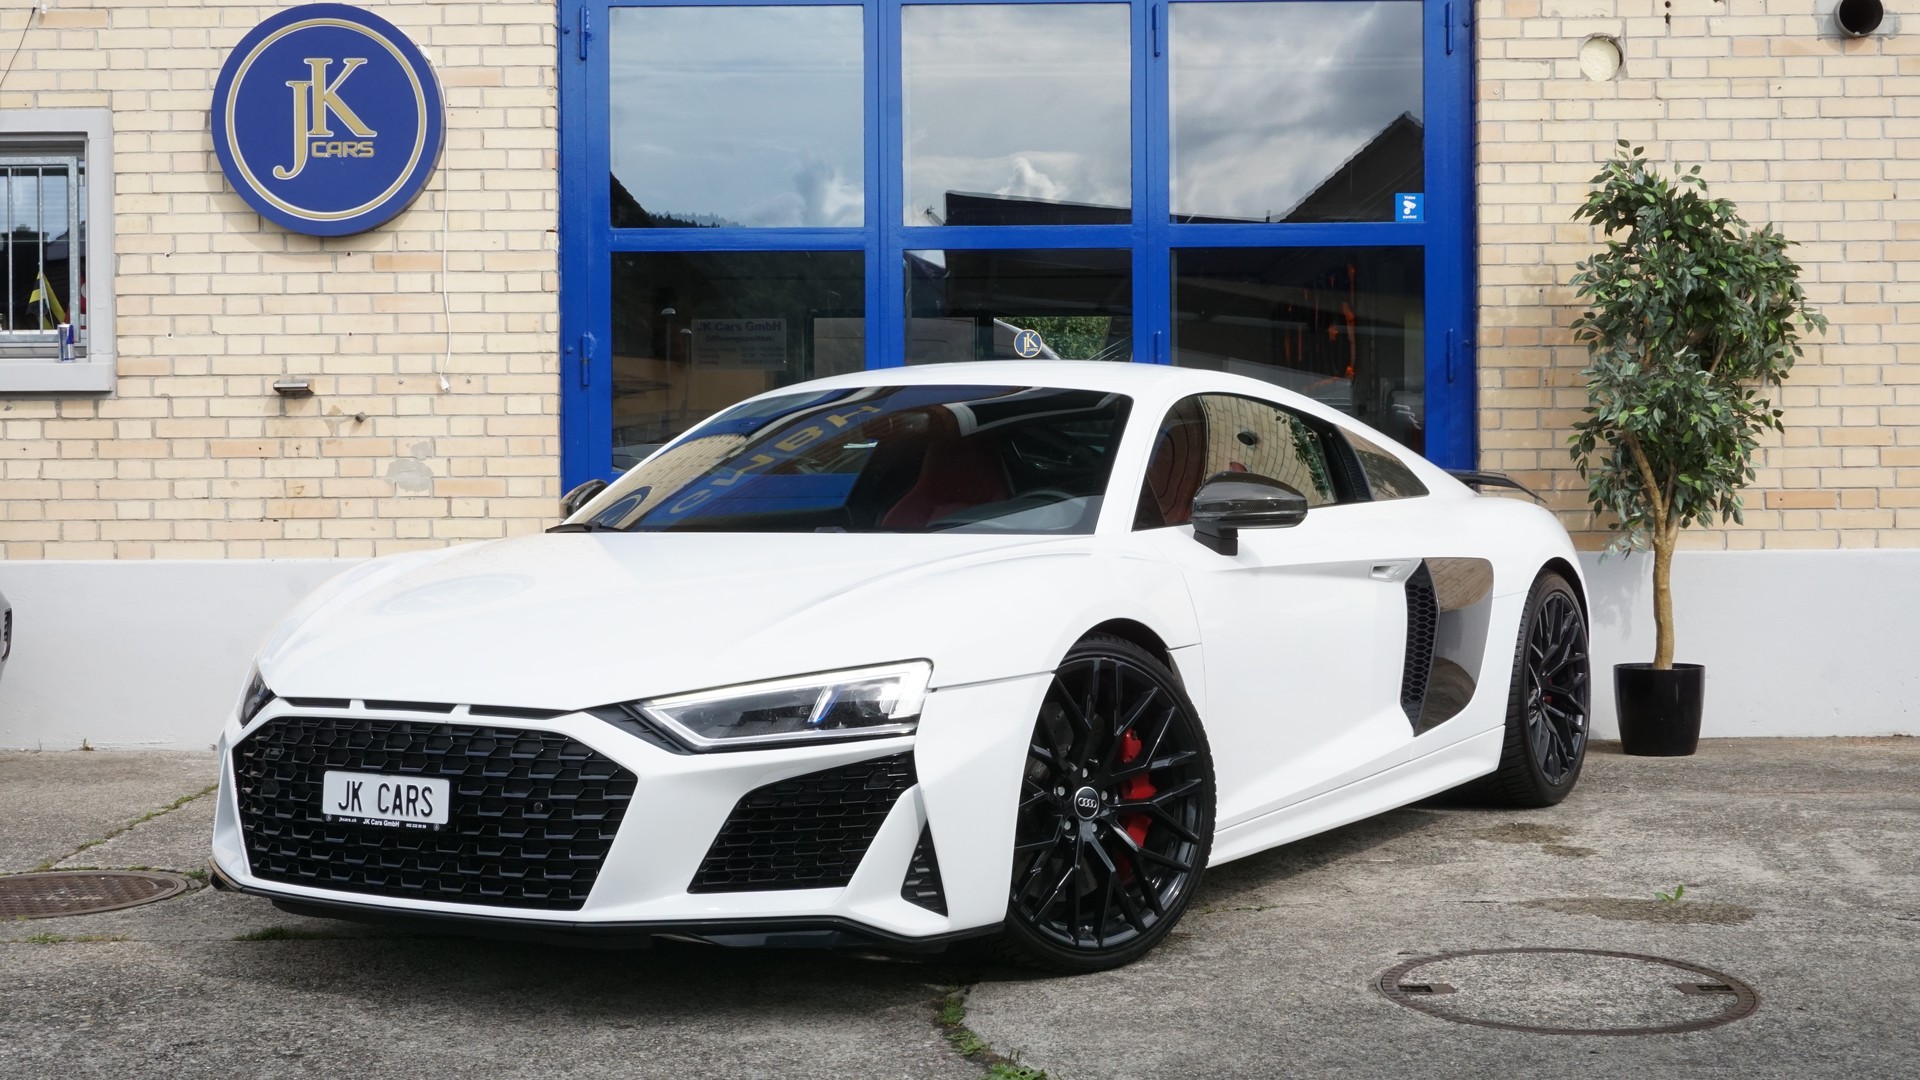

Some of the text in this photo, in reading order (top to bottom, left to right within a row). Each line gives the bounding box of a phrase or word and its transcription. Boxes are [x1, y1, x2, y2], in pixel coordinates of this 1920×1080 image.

[272, 57, 378, 181] JK
[311, 141, 375, 158] CARS
[715, 321, 742, 332] Cars
[745, 320, 781, 332] GmbH
[338, 780, 434, 817] JK CARS
[362, 818, 371, 826] JK
[371, 819, 383, 827] Cars
[383, 820, 400, 828] GmbH
